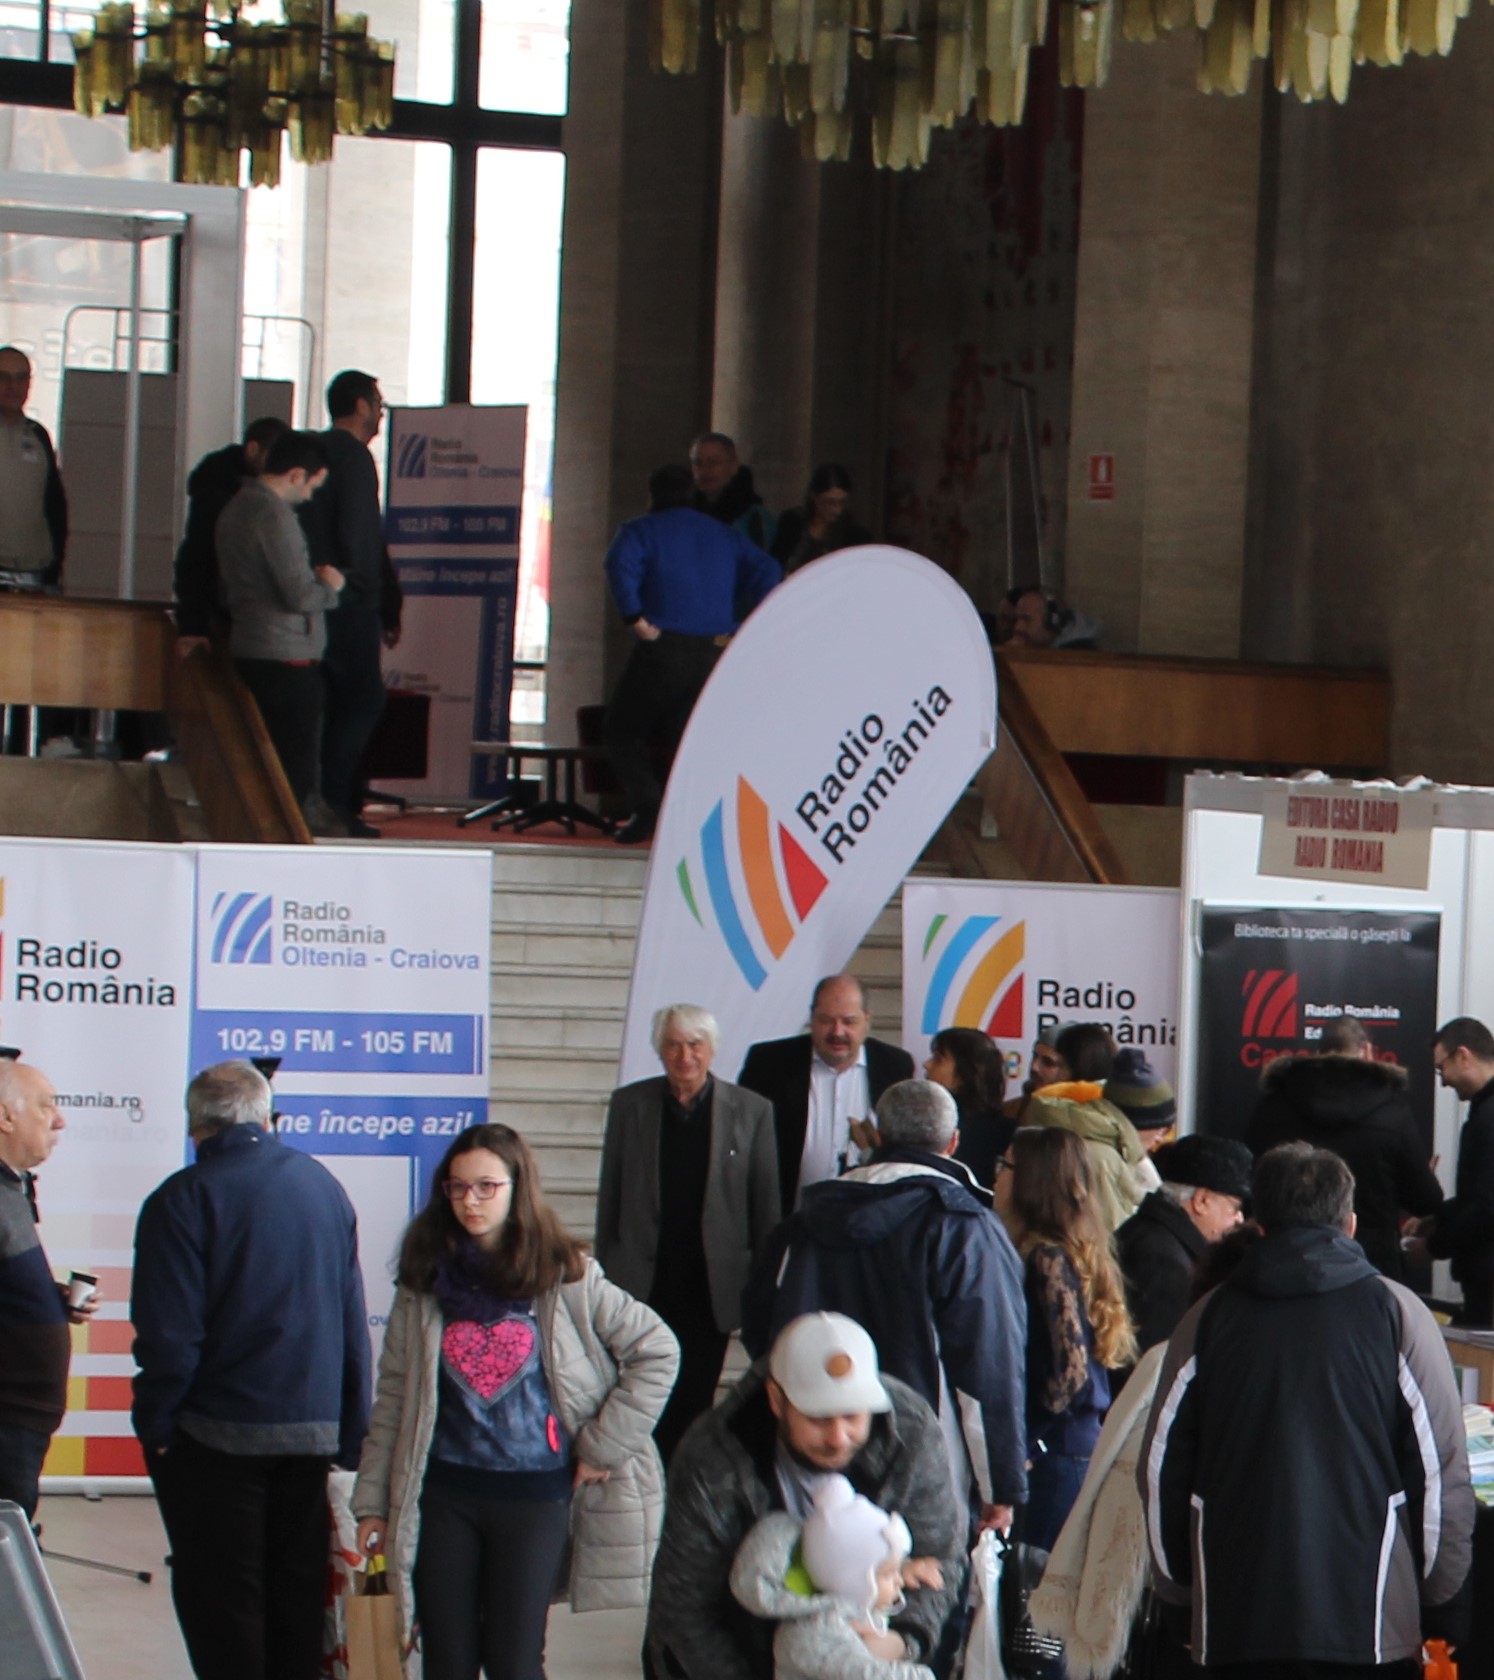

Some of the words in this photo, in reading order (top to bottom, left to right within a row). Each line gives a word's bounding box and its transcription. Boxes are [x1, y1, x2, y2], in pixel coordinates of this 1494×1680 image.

[795, 712, 885, 833] Radio
[820, 684, 953, 864] România
[283, 901, 351, 922] Radio
[283, 923, 387, 945] România
[16, 939, 122, 969] Radio
[281, 946, 368, 968] Oltenia
[390, 948, 480, 970] Craiova
[15, 974, 176, 1007] România
[1037, 979, 1136, 1010] Radio
[1305, 1003, 1343, 1018] Radio
[217, 1028, 286, 1056] 102,9
[294, 1030, 336, 1053] FM
[361, 1031, 405, 1054] 105
[412, 1032, 454, 1055] FM
[1037, 1013, 1177, 1047] Râni
[52, 1091, 141, 1110] mania.ro
[319, 1110, 416, 1141] începe
